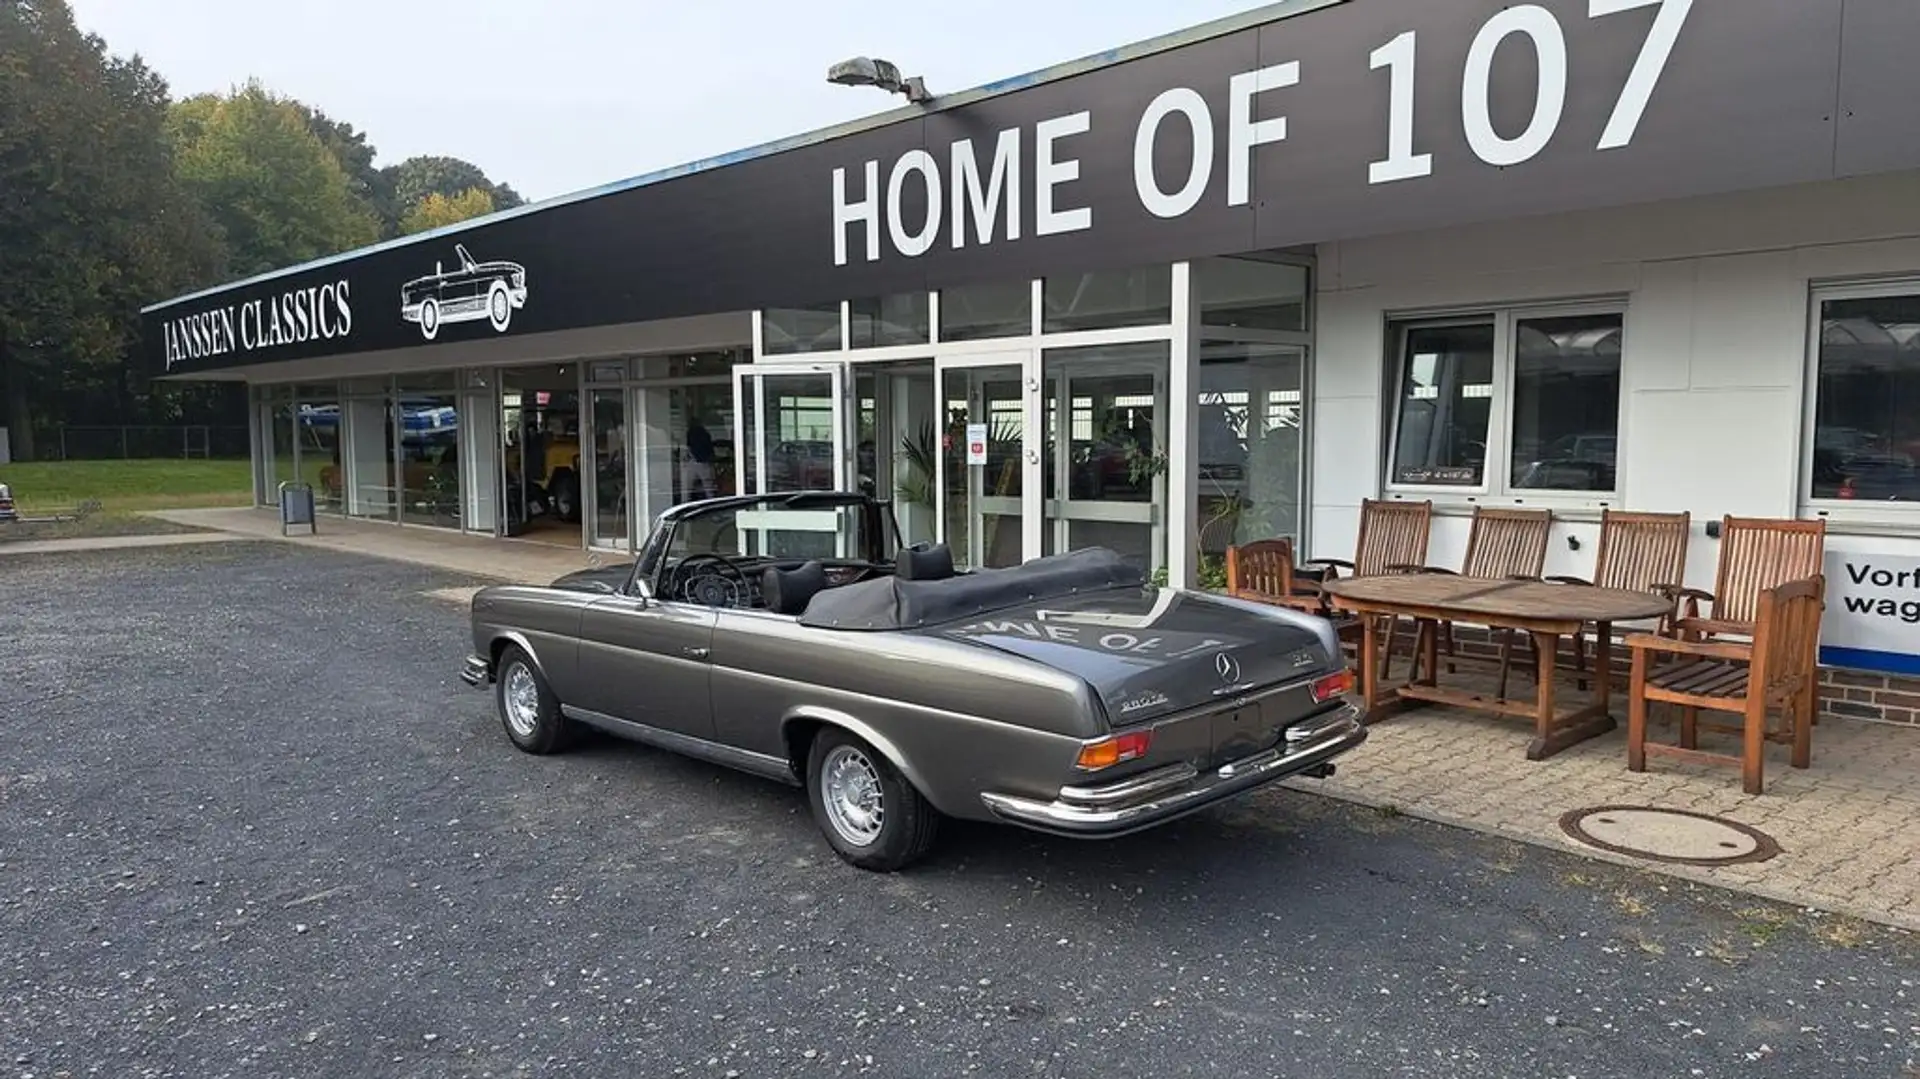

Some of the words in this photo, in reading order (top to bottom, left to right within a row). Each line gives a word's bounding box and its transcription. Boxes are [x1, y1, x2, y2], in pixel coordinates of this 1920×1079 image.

[832, 110, 1092, 266] HOME
[1133, 59, 1300, 218] OF
[1368, 0, 1695, 185] 107
[163, 306, 236, 371] JANSSEN
[240, 279, 352, 351] CLASSICS
